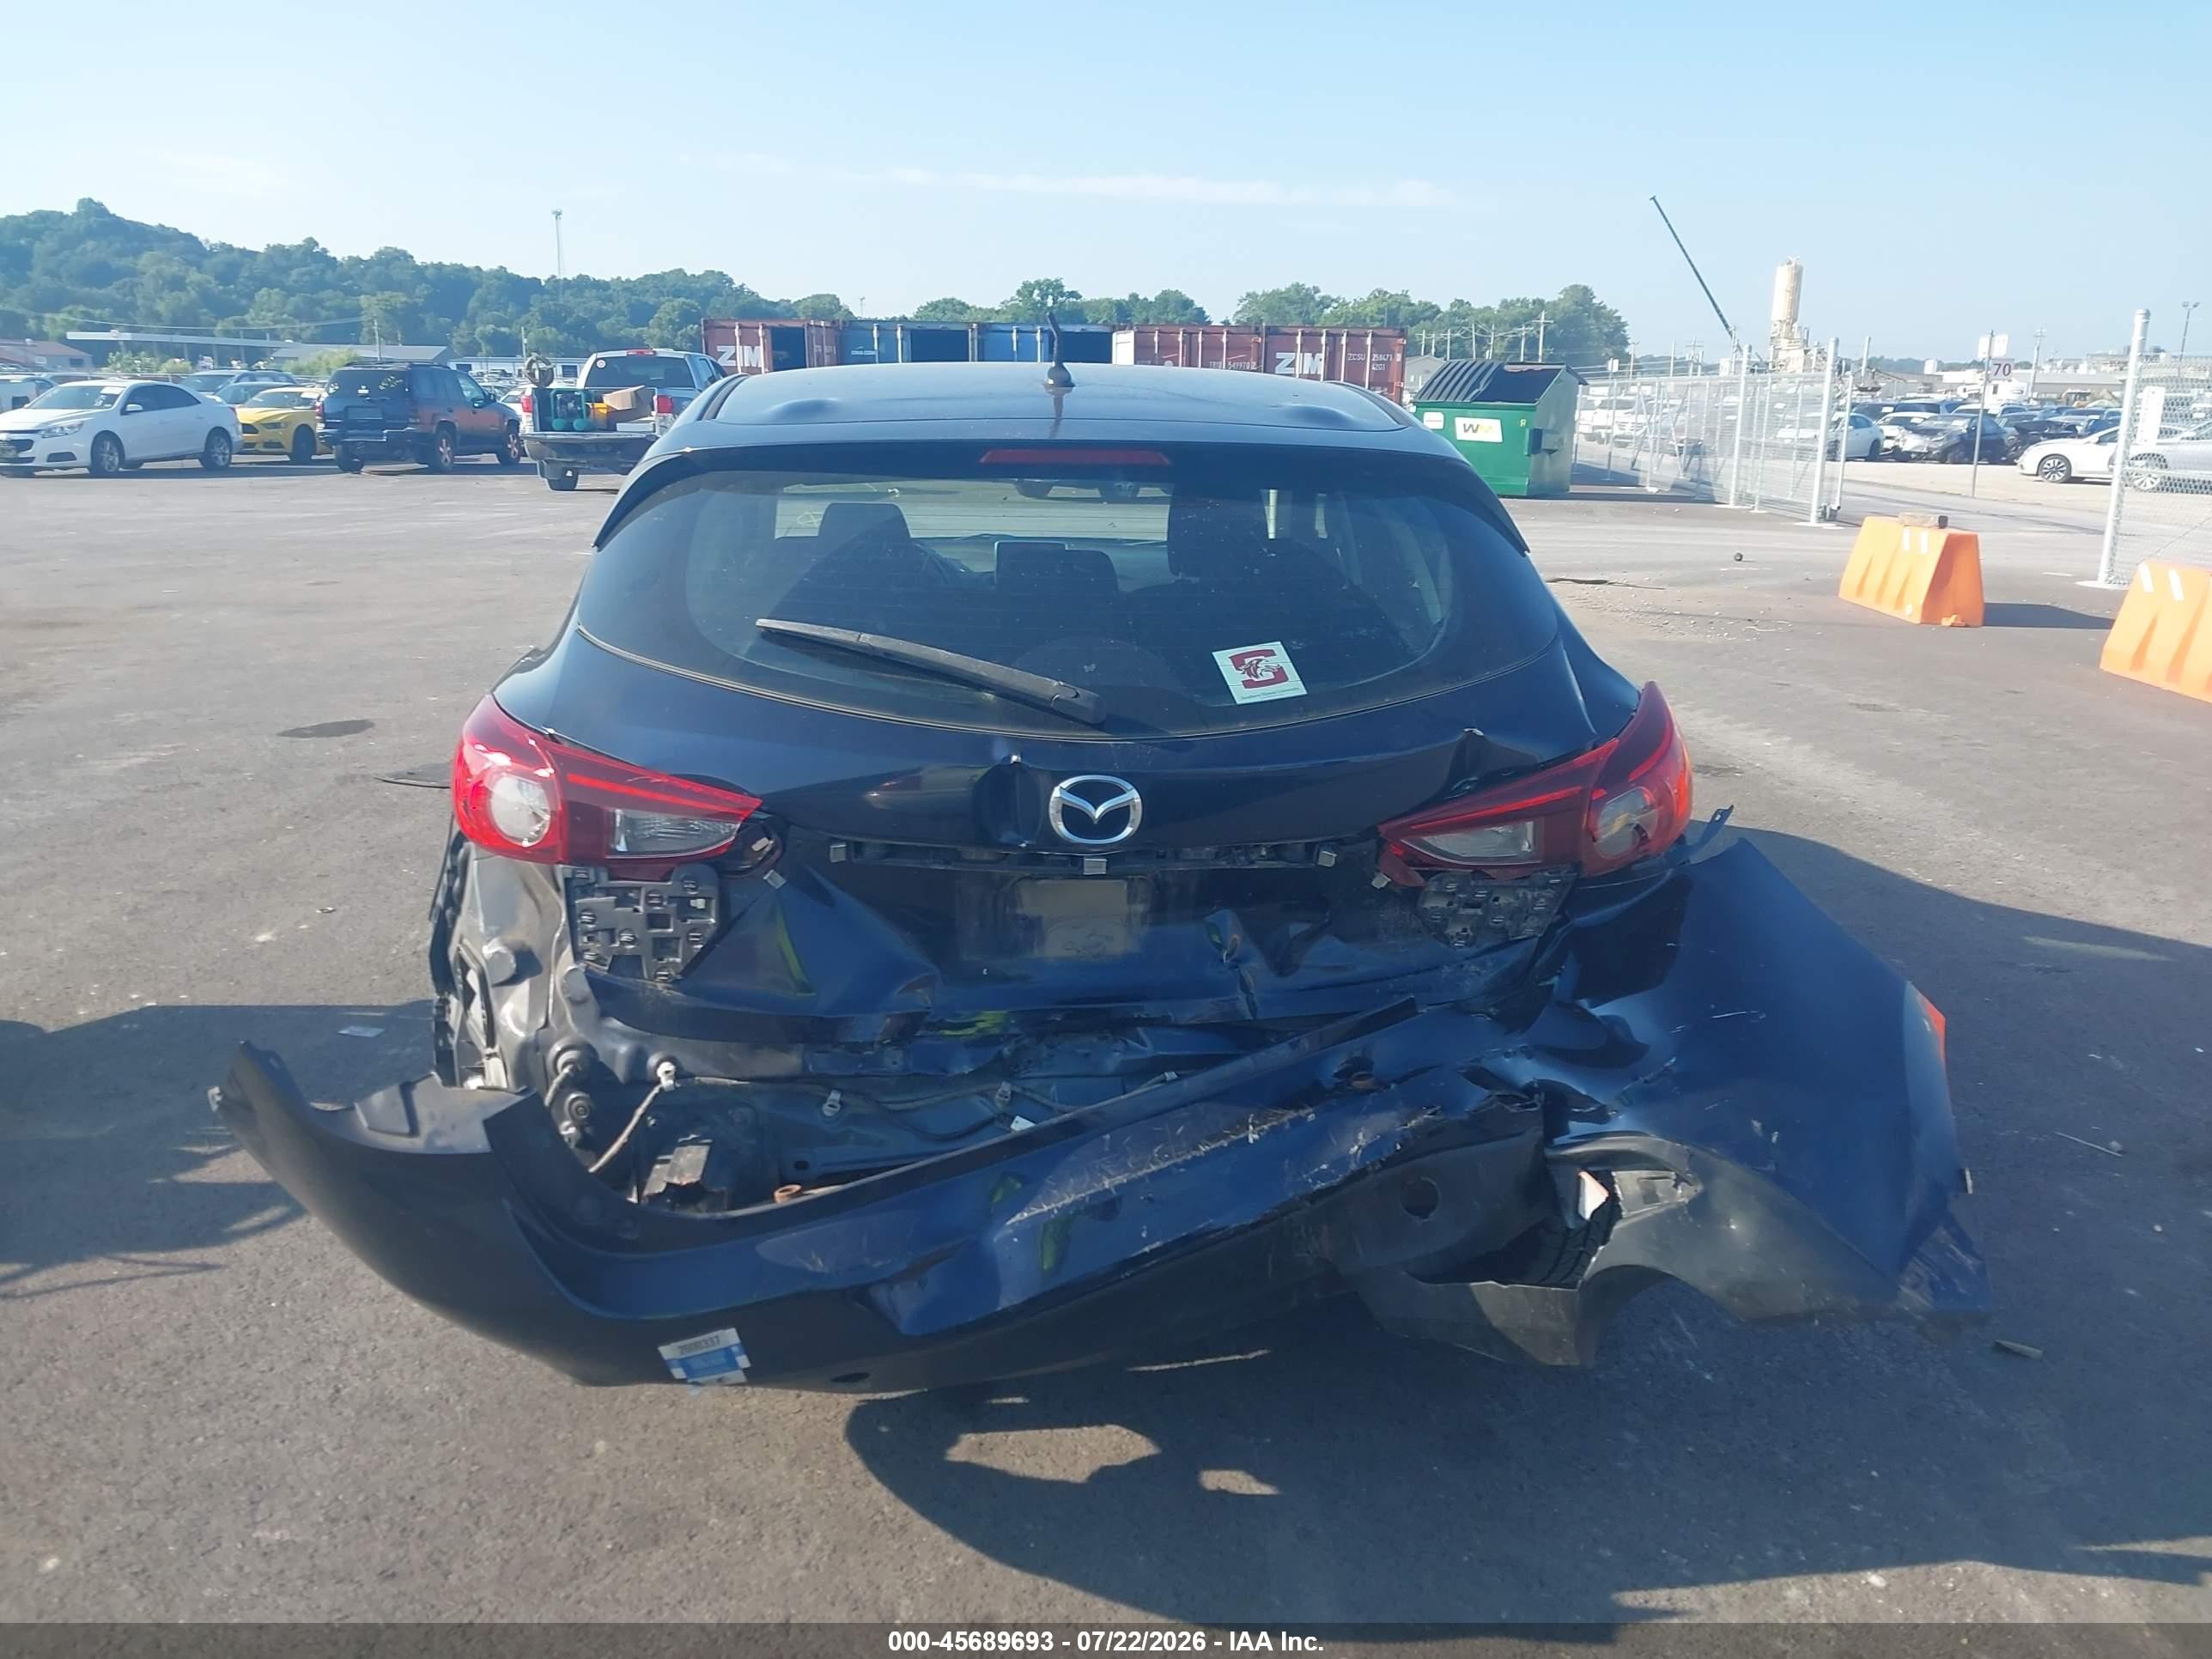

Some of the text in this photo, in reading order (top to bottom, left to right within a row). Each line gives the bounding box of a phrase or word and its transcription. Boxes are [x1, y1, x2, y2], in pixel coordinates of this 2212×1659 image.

[716, 345, 762, 368] ZIM
[1274, 352, 1323, 374] ZIM
[1993, 362, 2012, 377] 70
[1462, 422, 1496, 434] WM
